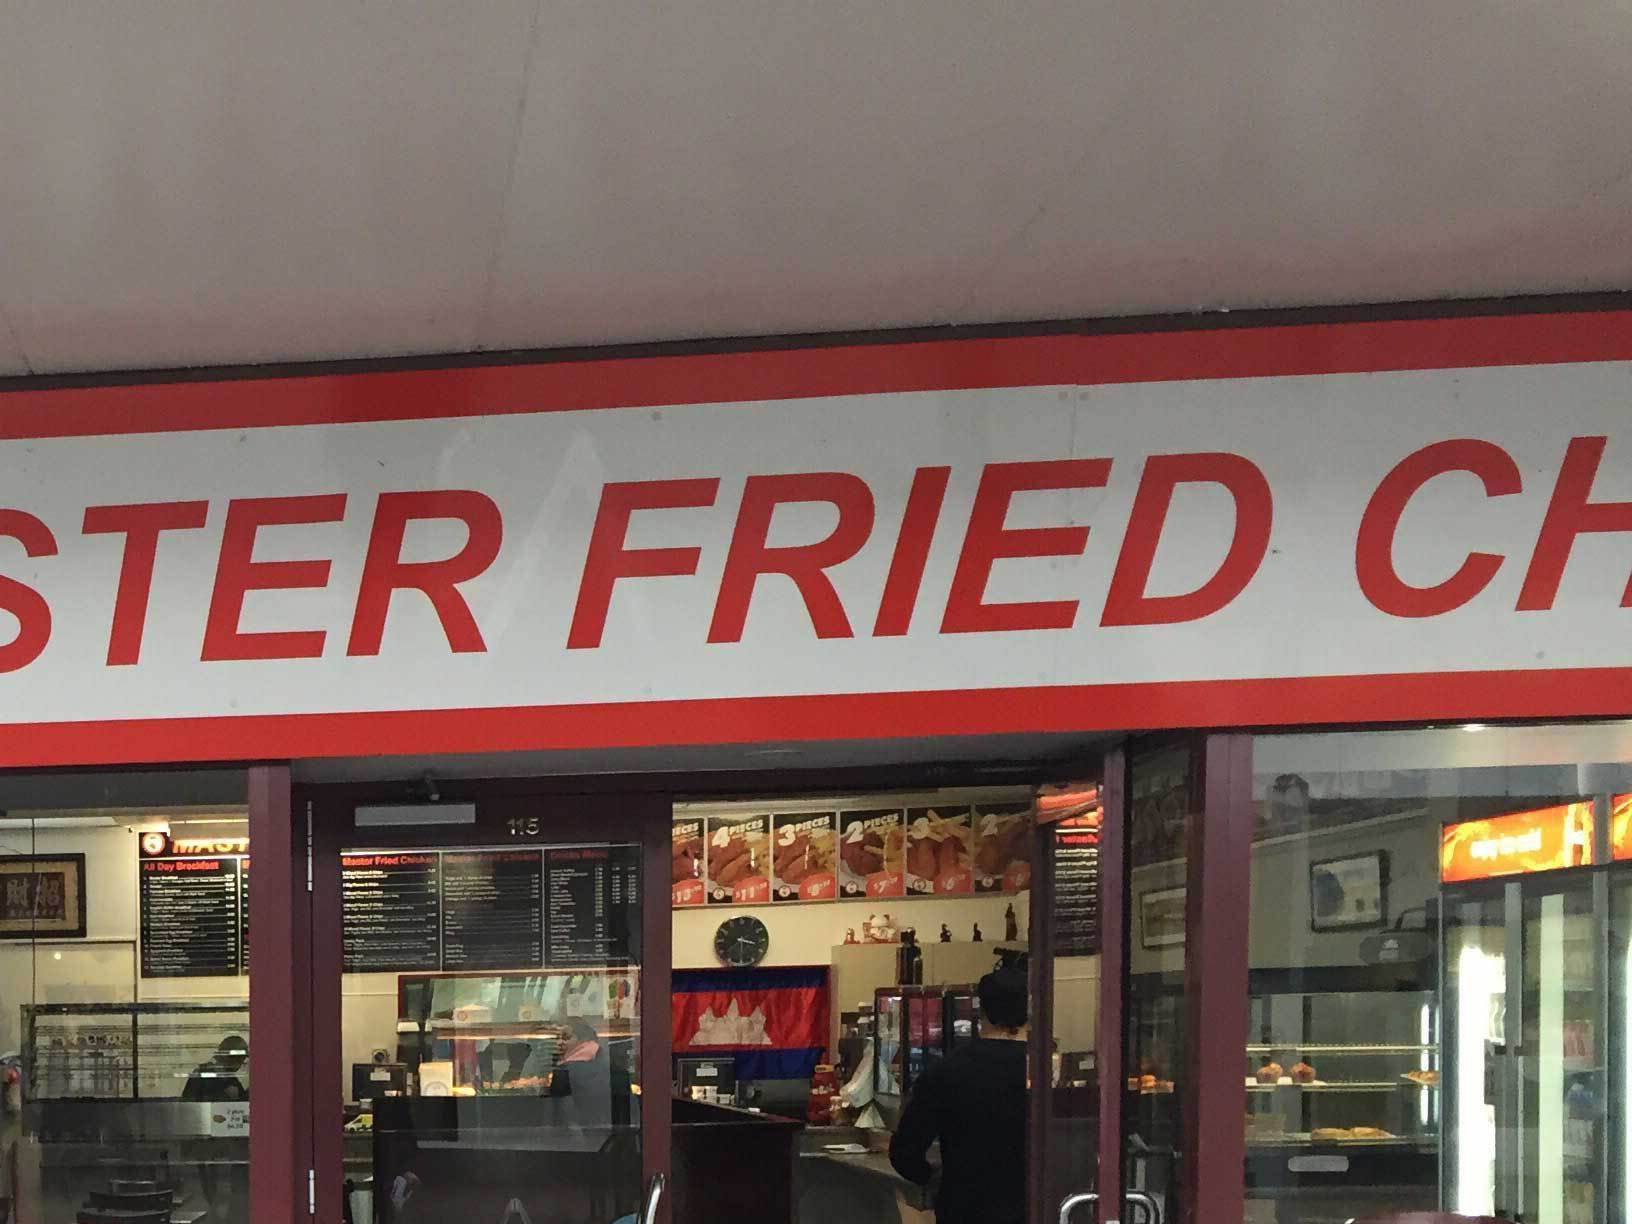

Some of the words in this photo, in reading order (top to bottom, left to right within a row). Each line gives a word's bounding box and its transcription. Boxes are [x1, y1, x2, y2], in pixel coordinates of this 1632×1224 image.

[568, 454, 1272, 648] FRIED
[507, 818, 540, 835] 115
[712, 826, 730, 848] 4
[778, 824, 796, 847] 3
[846, 821, 864, 844] 2
